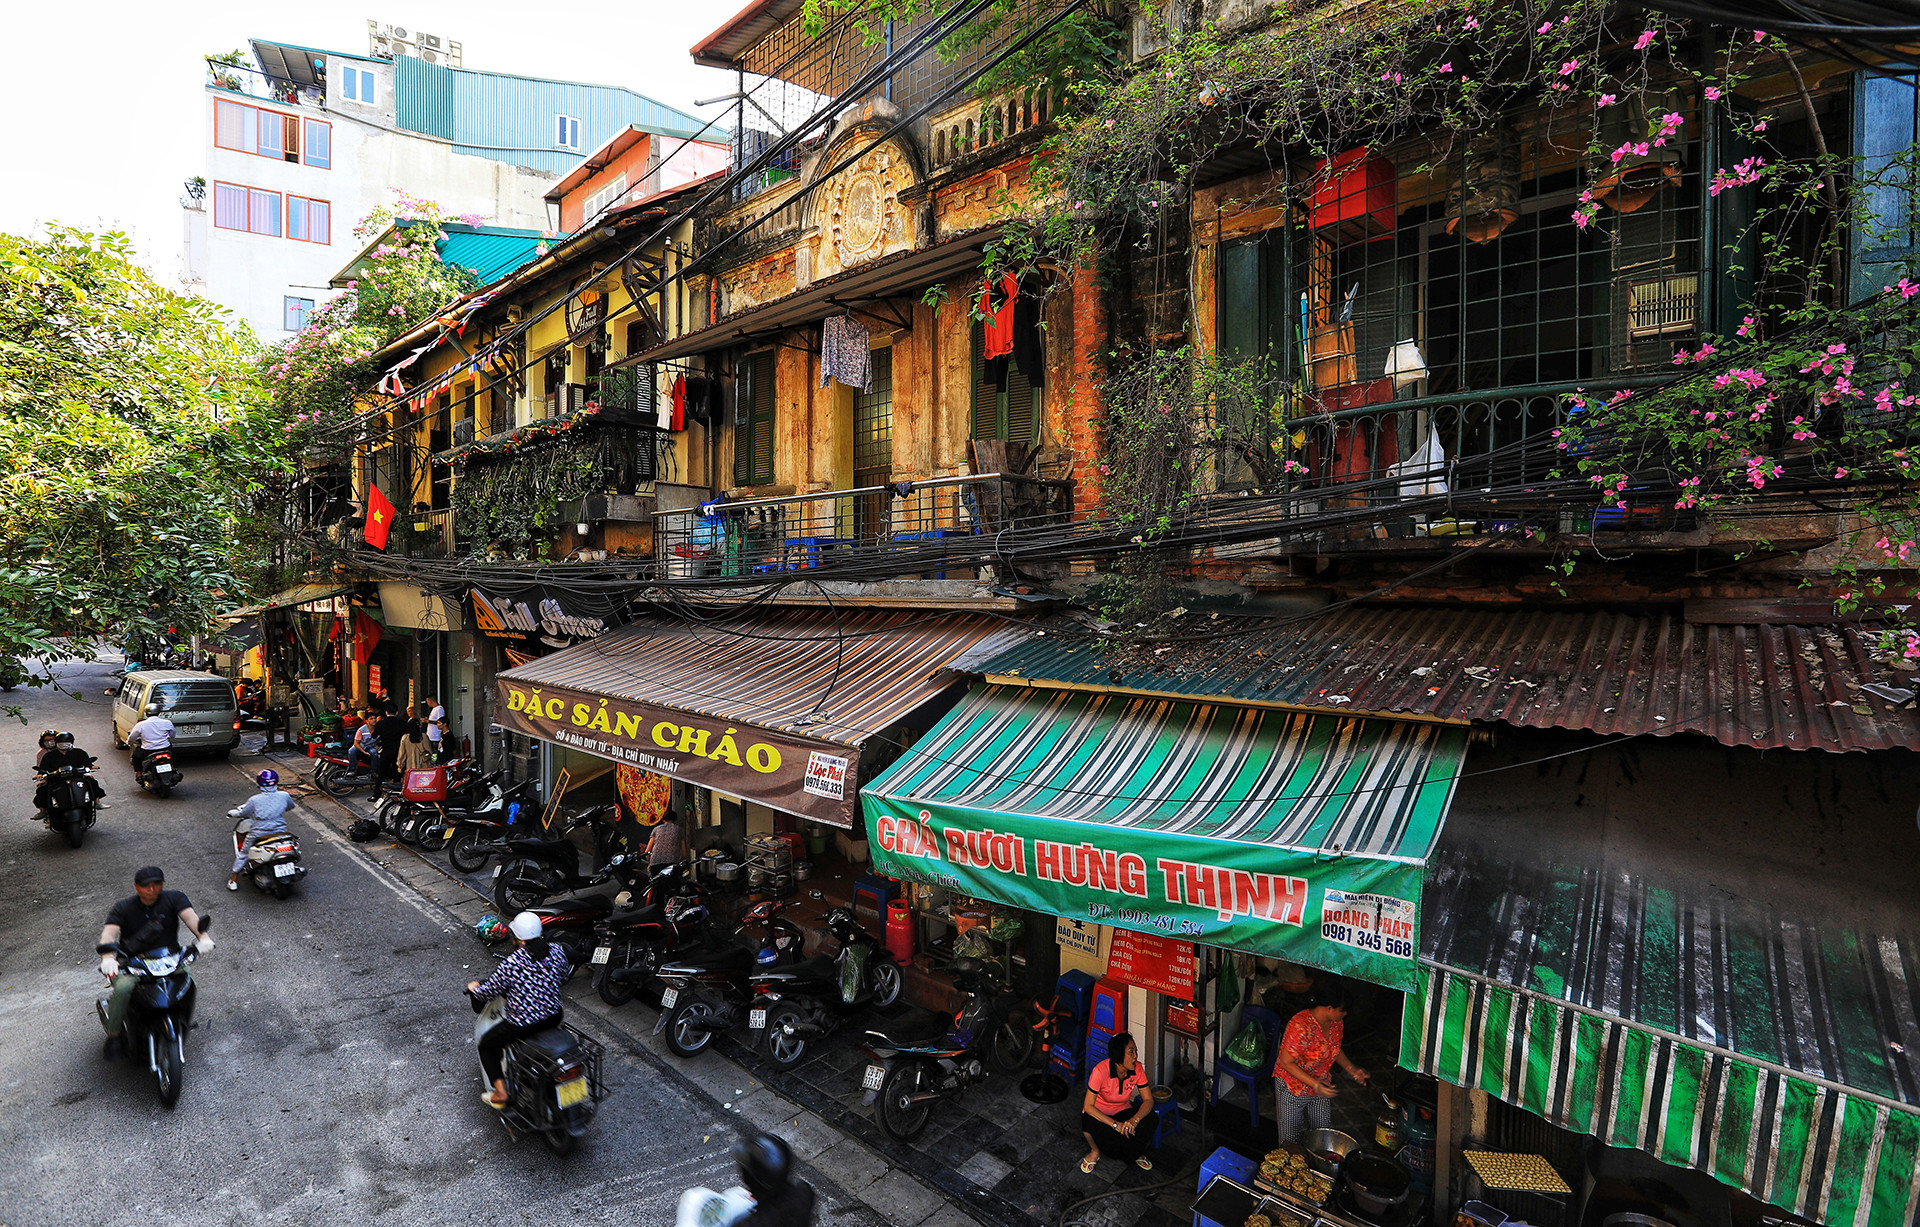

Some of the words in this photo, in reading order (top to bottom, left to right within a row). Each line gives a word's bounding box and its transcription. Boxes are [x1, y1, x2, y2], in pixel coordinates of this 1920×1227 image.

[506, 687, 565, 721] ĐẶC
[571, 698, 643, 740] SẢN
[651, 721, 782, 774] CHÁO
[555, 728, 565, 741] SỐ
[565, 732, 570, 742] 4
[570, 732, 583, 746] ĐÀO
[584, 737, 597, 750] DUY
[611, 744, 624, 760] ĐỊA
[625, 747, 638, 762] CHỈ
[639, 753, 654, 767] DUY
[656, 757, 679, 773] NHẤT
[813, 762, 827, 779] Lộc
[826, 765, 843, 781] Phát
[876, 809, 941, 860] CHẢ
[943, 827, 1027, 877] RƯƠI
[1034, 839, 1149, 899] HƯNG
[1156, 857, 1309, 928] THỊNH
[1058, 925, 1071, 937] ĐÀO
[1072, 931, 1086, 942] DUY
[1087, 902, 1115, 921] ĐT:
[1118, 906, 1150, 925] 0903
[1151, 911, 1177, 932] 481
[1178, 920, 1203, 937] 584
[1323, 907, 1370, 929] HOÀNG
[1373, 916, 1412, 939] PHÁT
[1322, 923, 1352, 943] 0981
[1356, 931, 1382, 950] 345
[1385, 937, 1412, 957] 568
[1143, 977, 1157, 987] SHIP
[1157, 980, 1176, 991] HÀNG
